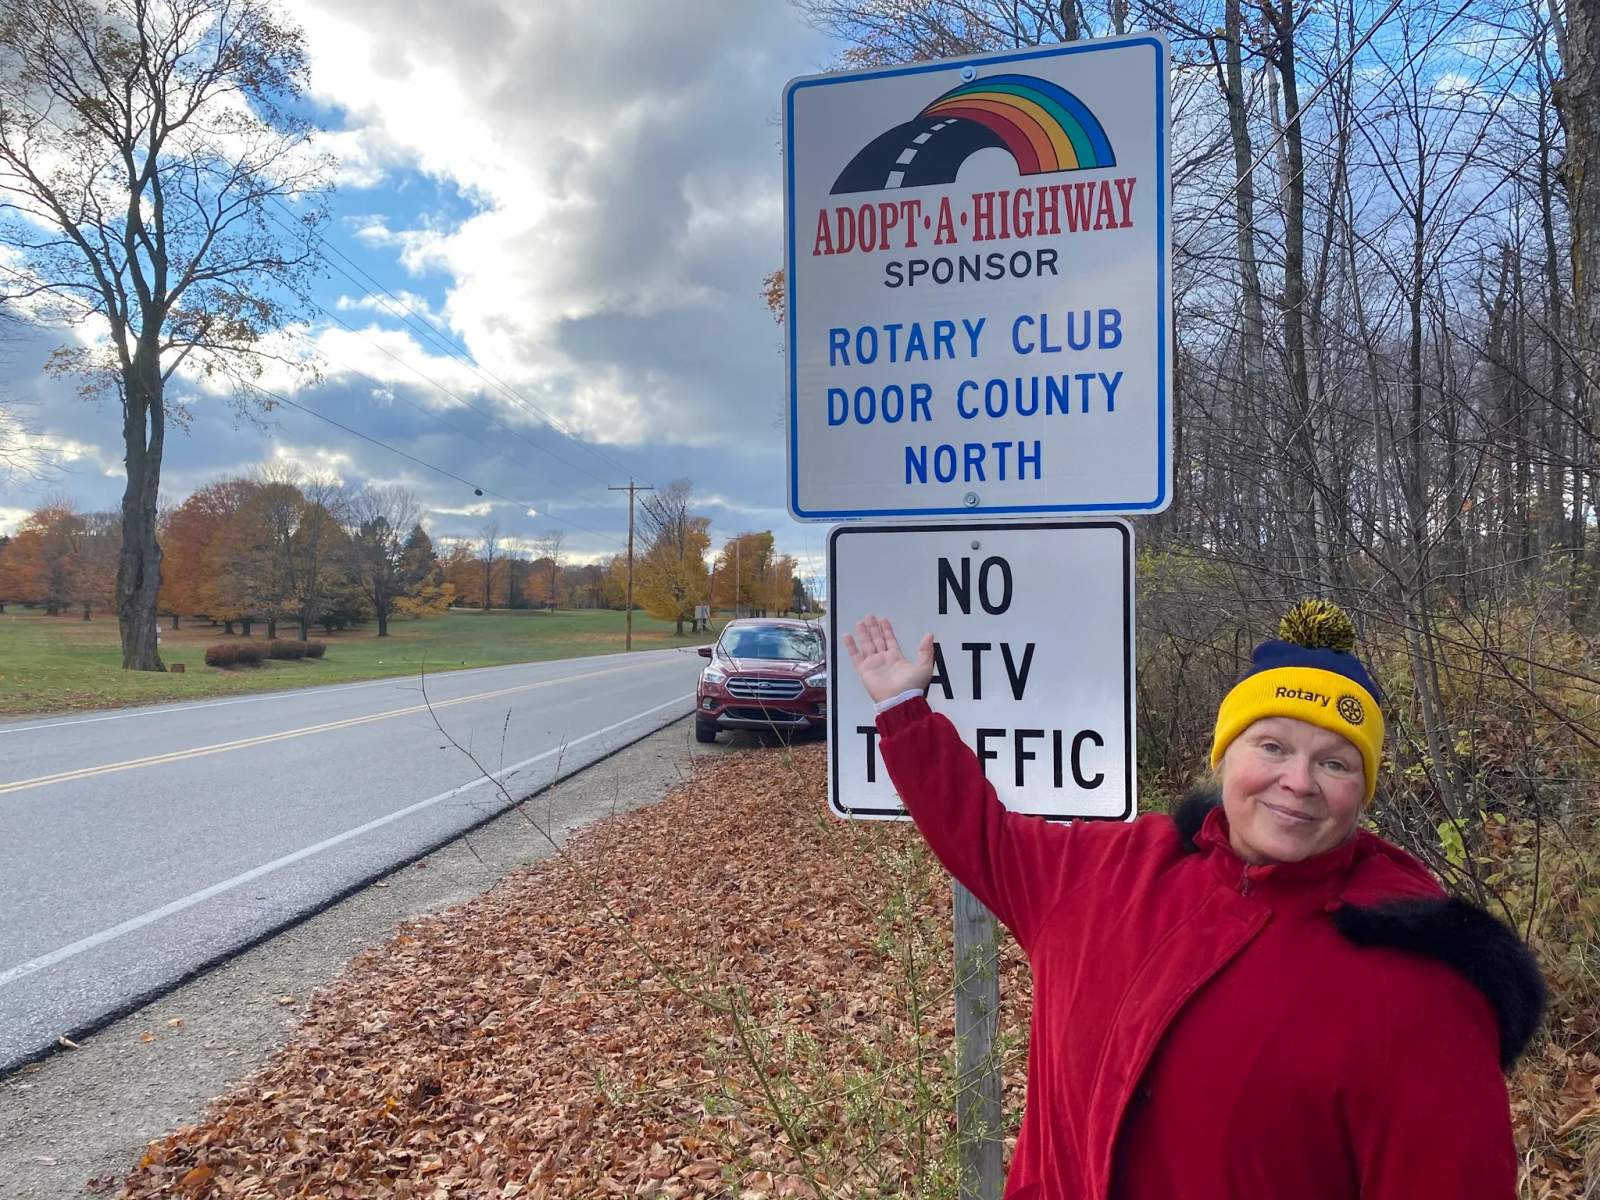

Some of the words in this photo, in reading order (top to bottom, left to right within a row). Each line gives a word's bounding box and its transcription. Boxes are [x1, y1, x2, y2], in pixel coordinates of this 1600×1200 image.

[884, 248, 1059, 288] SPONSOR
[829, 317, 987, 367] ROTARY
[1012, 308, 1123, 355] CLUB
[827, 383, 933, 426] DOOR
[957, 371, 1124, 419] COUNTY
[905, 440, 1041, 484] NORTH
[938, 556, 1013, 615] NO
[923, 642, 1036, 701] ATV
[1275, 686, 1331, 707] Rotary
[856, 726, 1105, 789] TFFIC
